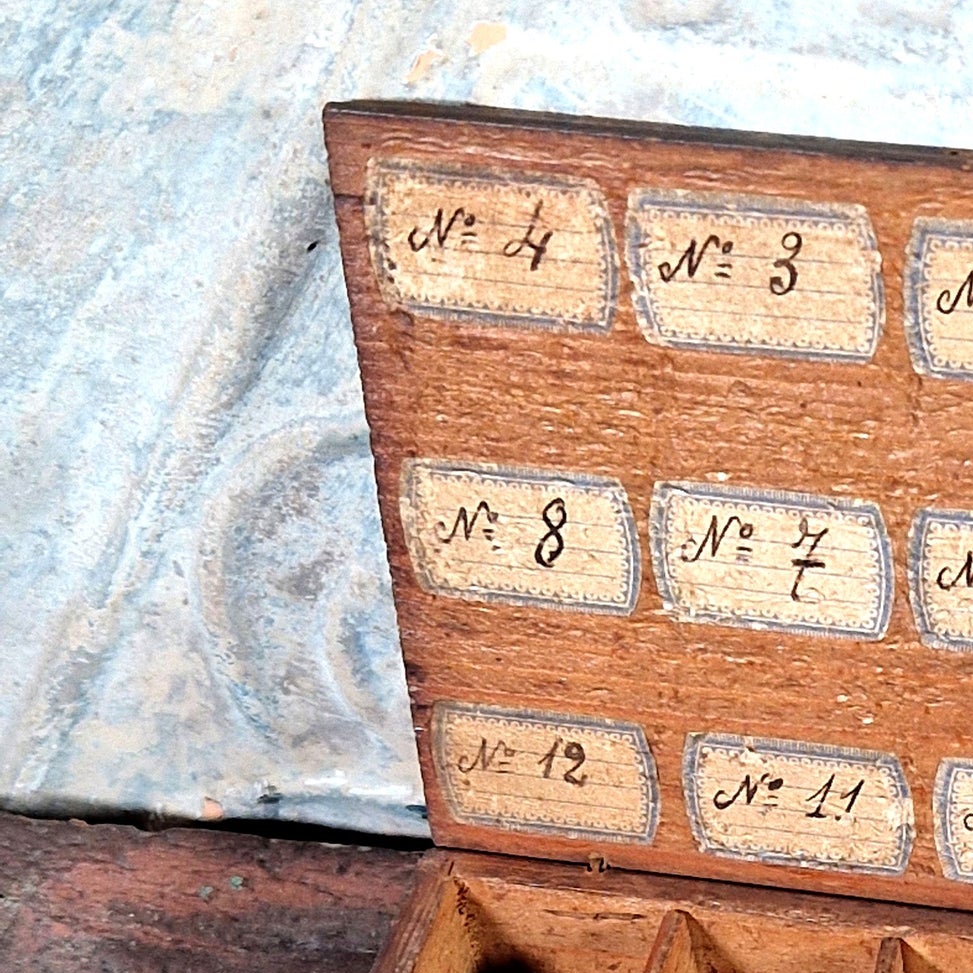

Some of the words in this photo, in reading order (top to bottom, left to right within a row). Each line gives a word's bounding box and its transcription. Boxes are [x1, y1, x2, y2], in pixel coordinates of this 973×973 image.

[503, 200, 553, 271] 4
[769, 231, 802, 296] 3
[534, 498, 567, 568] 8
[790, 518, 829, 602] 7
[538, 736, 588, 787] 12
